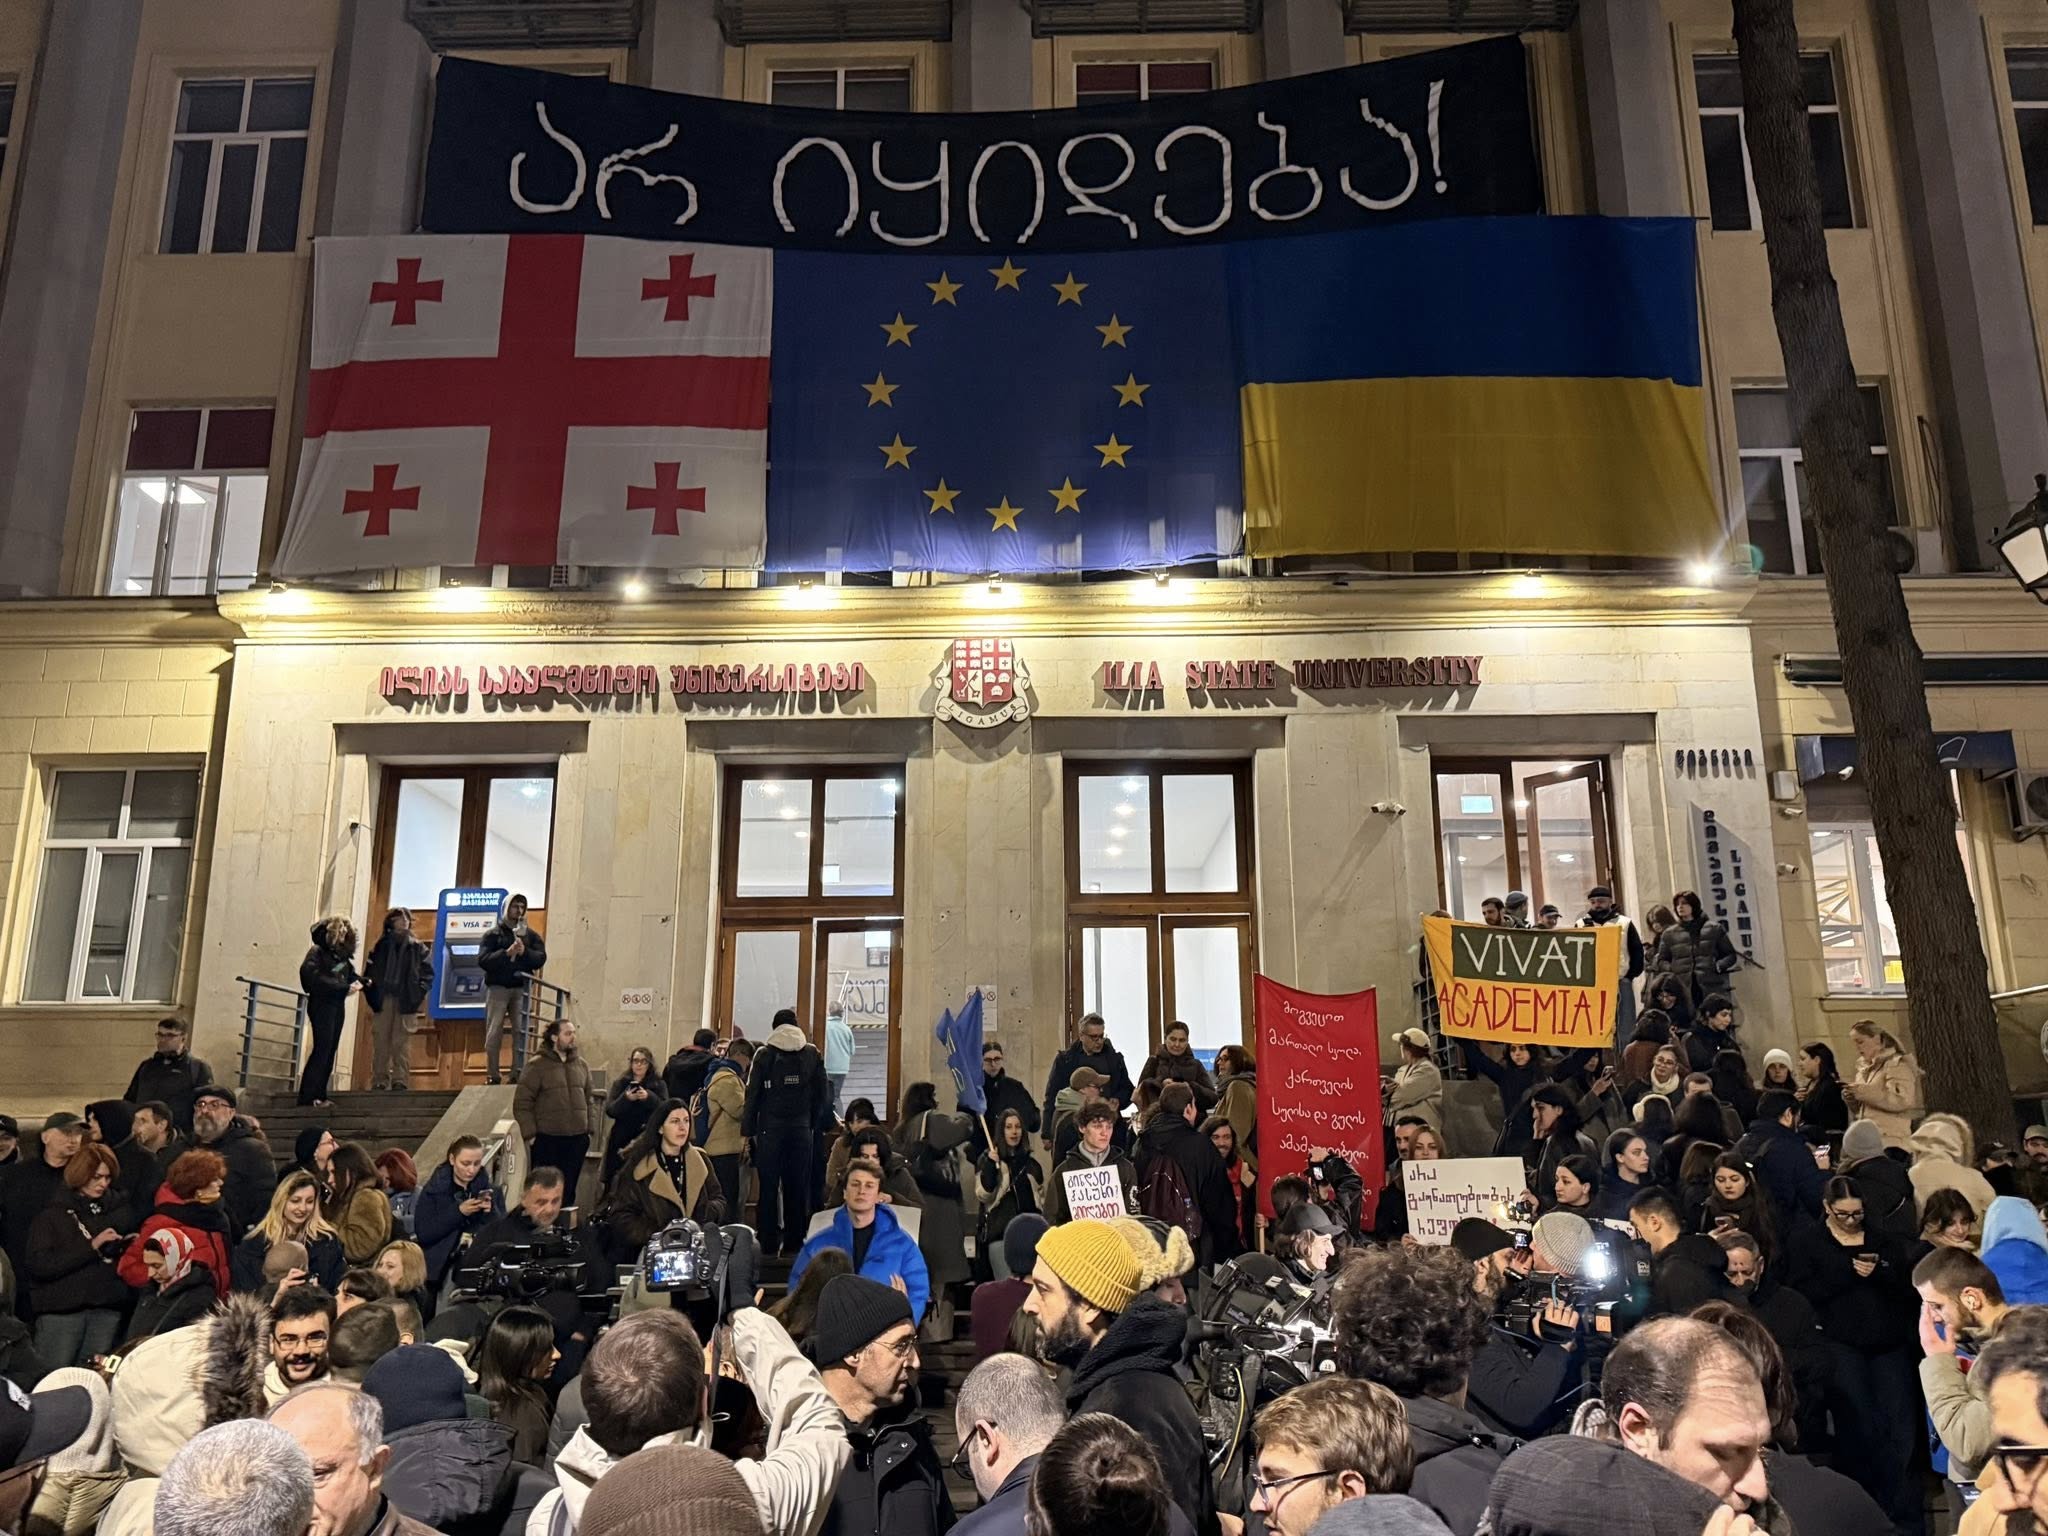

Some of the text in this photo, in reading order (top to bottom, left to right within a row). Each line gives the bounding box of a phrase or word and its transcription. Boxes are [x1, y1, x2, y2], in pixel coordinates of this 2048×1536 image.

[509, 78, 1451, 246] არ იყიდება!
[379, 662, 866, 696] ილიას სახელმწიფო უნივერსიტეტი
[1102, 655, 1484, 690] ILIA STATE UNIVERSITY
[948, 703, 1017, 726] LIGAMUS
[1460, 932, 1595, 980] VIVAT
[1283, 1000, 1344, 1027] მოგვეცით
[1438, 982, 1607, 1036] ACADEMIA!
[1269, 1028, 1323, 1057] მართალი
[1285, 1068, 1354, 1096] ქართველის
[1271, 1097, 1366, 1131] სულისა და გულის
[1067, 1171, 1111, 1188] გინდათ
